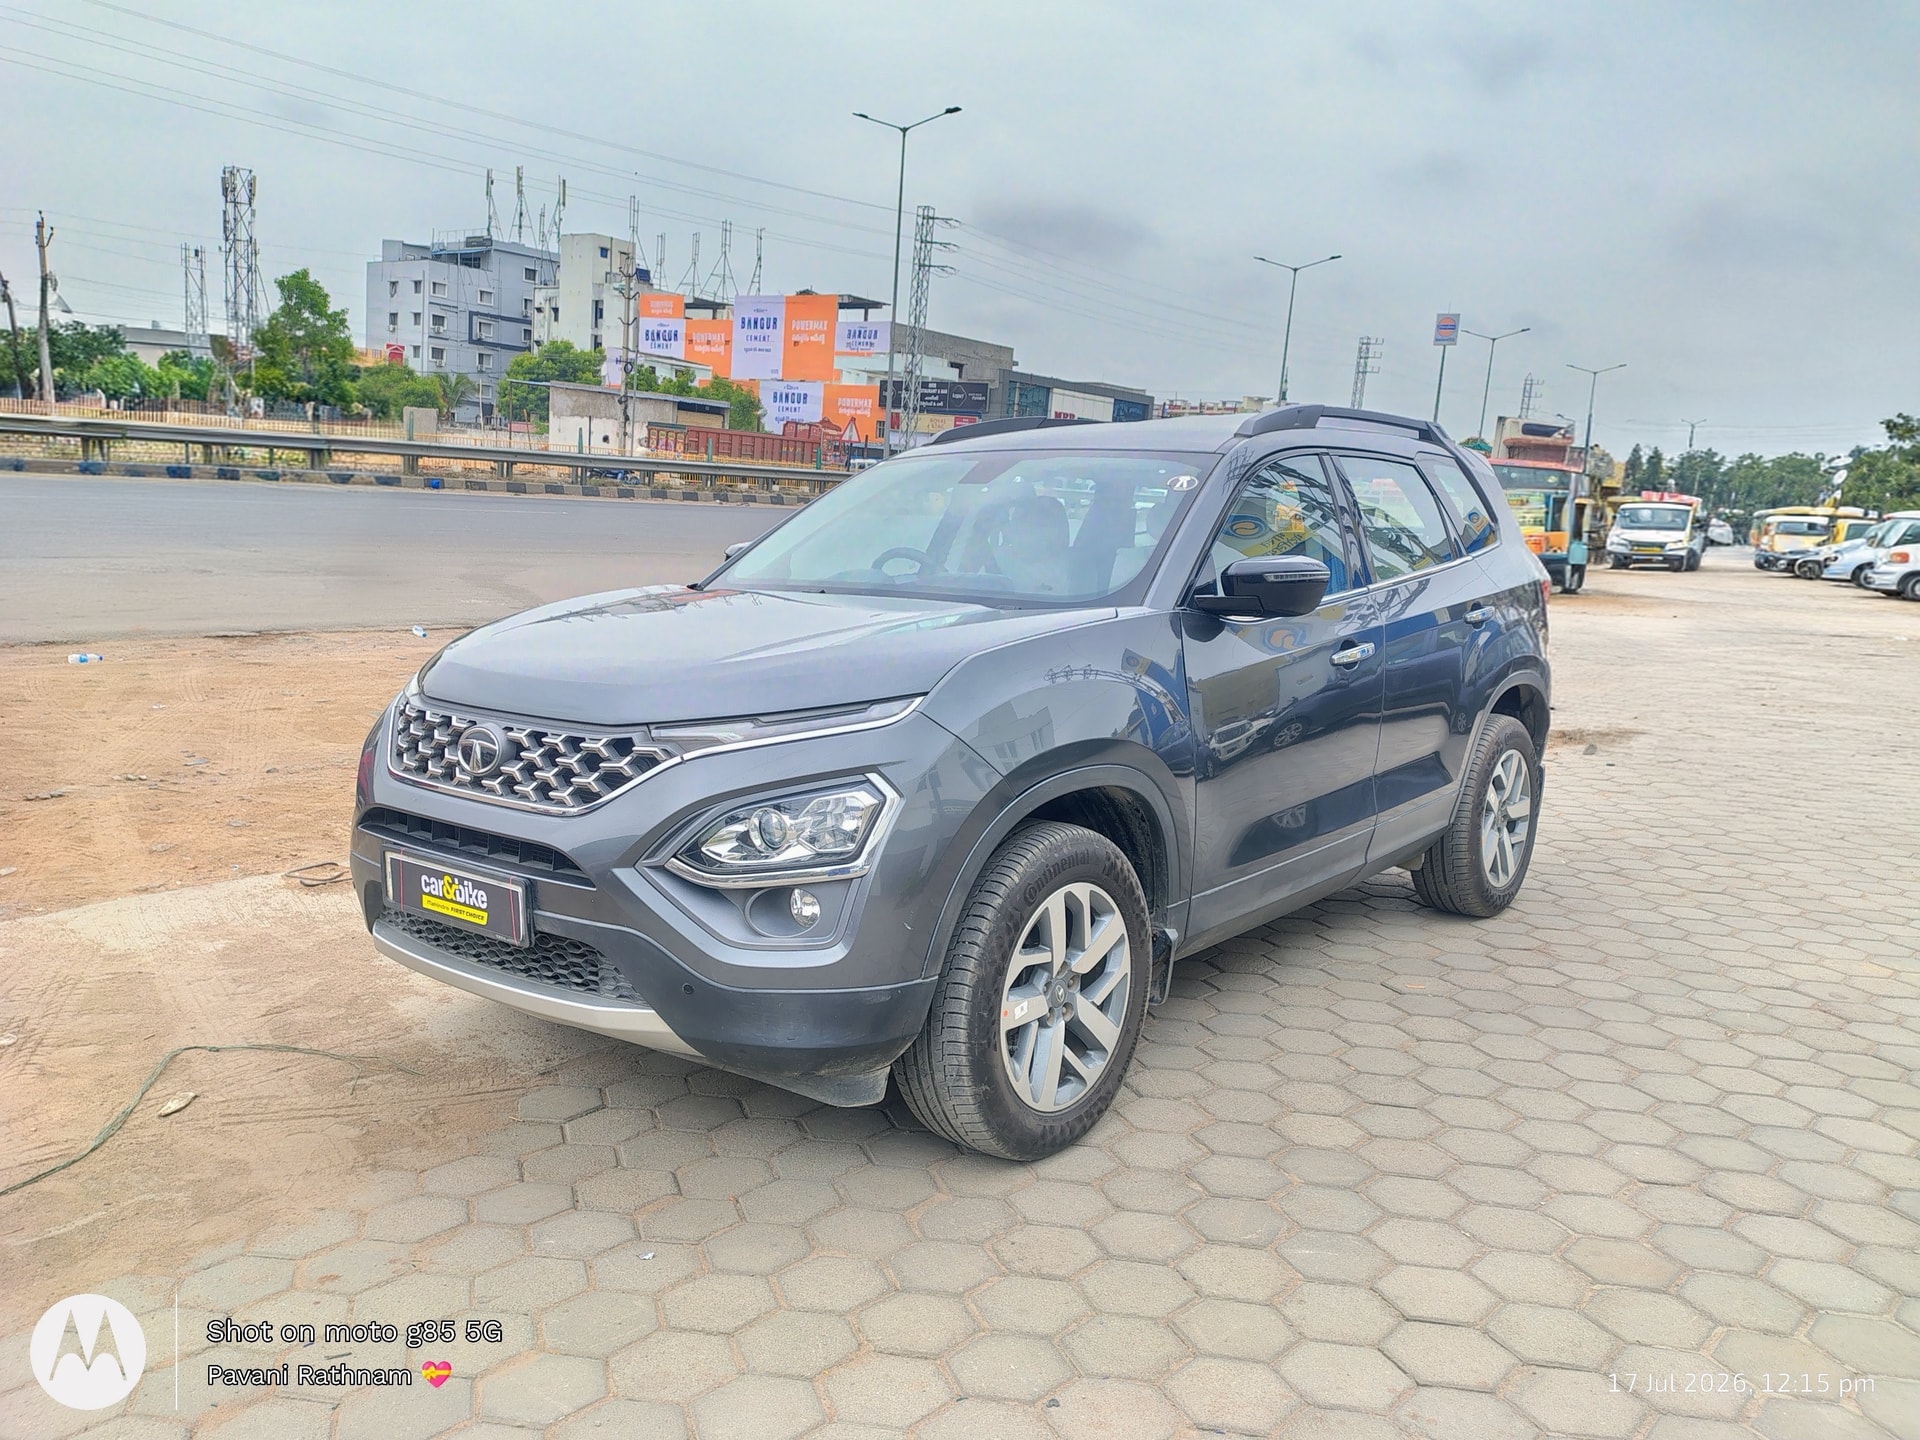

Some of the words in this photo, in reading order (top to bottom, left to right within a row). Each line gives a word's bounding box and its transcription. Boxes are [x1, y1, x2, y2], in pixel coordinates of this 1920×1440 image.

[740, 317, 778, 330] BANGUR
[645, 329, 679, 342] BANGUR
[746, 334, 771, 342] CEMENT
[847, 329, 878, 340] BANGUR
[650, 342, 673, 350] CEMENT
[773, 391, 808, 405] BANGUR
[1023, 849, 1089, 907] Continental
[421, 874, 488, 909] car&bike
[450, 906, 466, 916] FIRST
[465, 911, 485, 921] CHOICE
